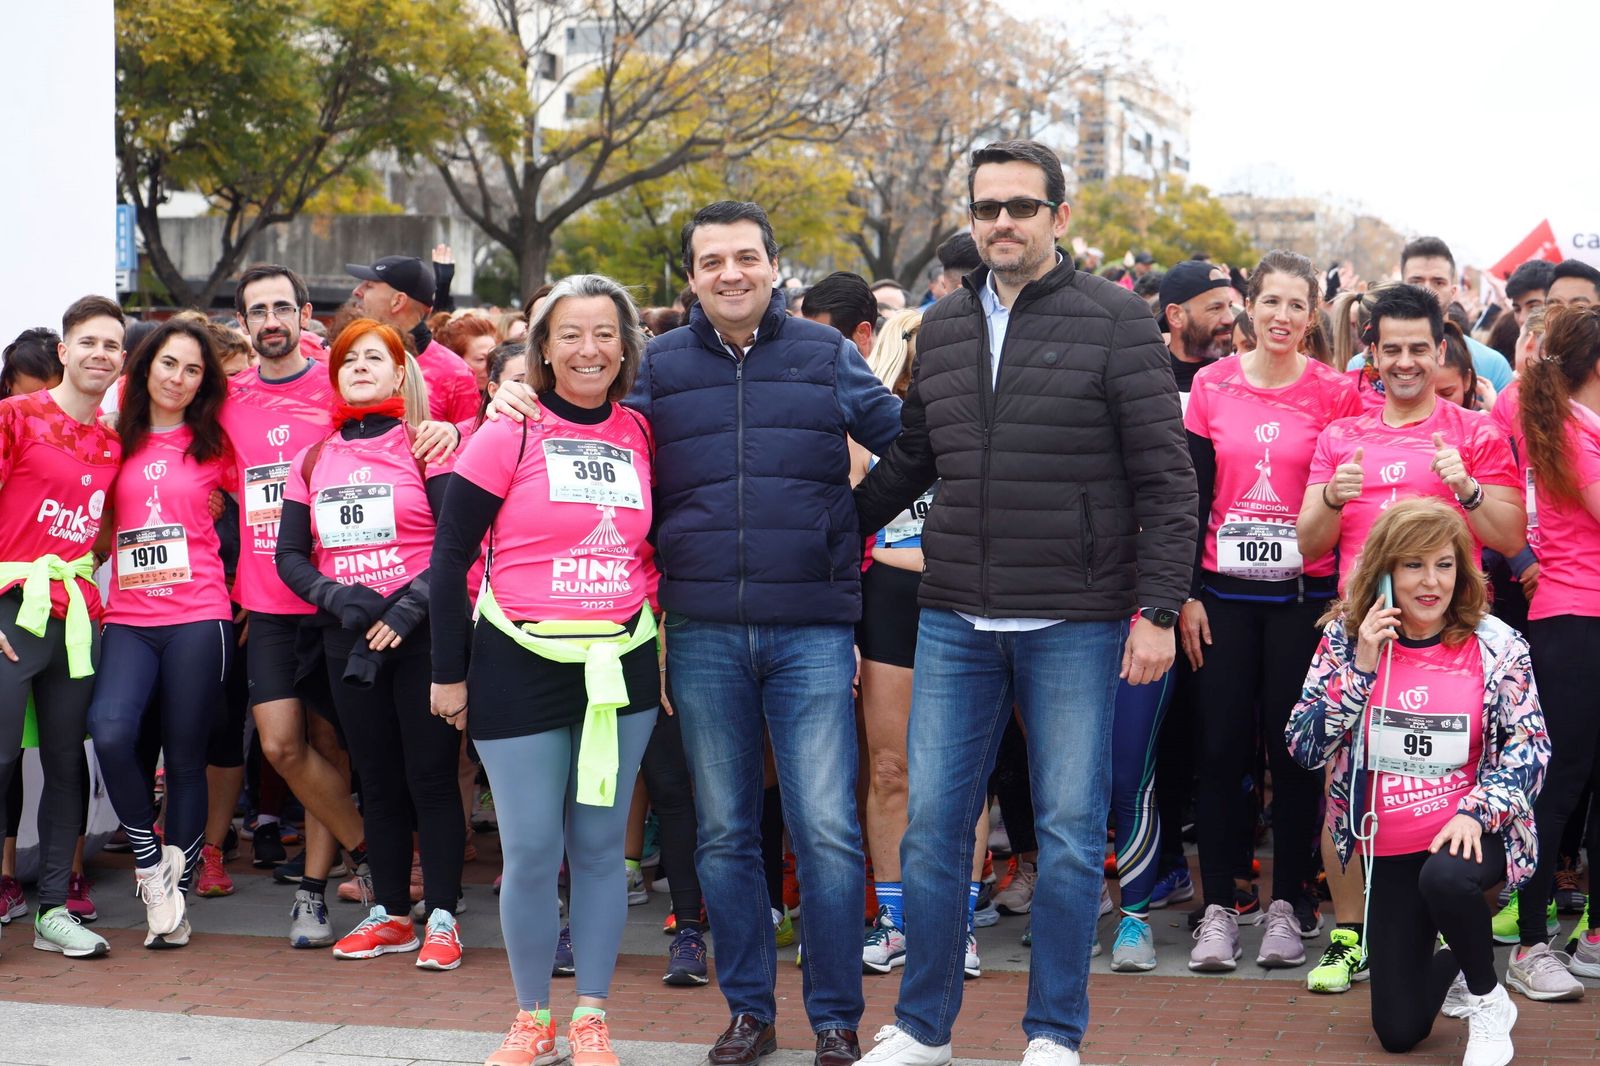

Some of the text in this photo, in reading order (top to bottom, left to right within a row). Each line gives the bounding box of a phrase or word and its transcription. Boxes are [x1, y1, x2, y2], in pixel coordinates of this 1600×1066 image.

[573, 460, 616, 483] 396
[37, 498, 89, 534] Pink
[340, 504, 364, 525] 86
[910, 501, 930, 519] 19
[1251, 503, 1289, 512] EDICIÓN
[131, 544, 168, 568] 1970
[334, 546, 404, 575] PINK
[1237, 541, 1282, 562] 1020
[336, 565, 406, 586] RUNNING
[552, 557, 630, 581] PINK
[146, 587, 173, 597] 2023
[551, 580, 631, 594] RUNNING
[580, 600, 614, 609] 2023
[1403, 733, 1433, 757] 95
[1382, 769, 1467, 794] PINK
[1413, 798, 1449, 817] 2023
